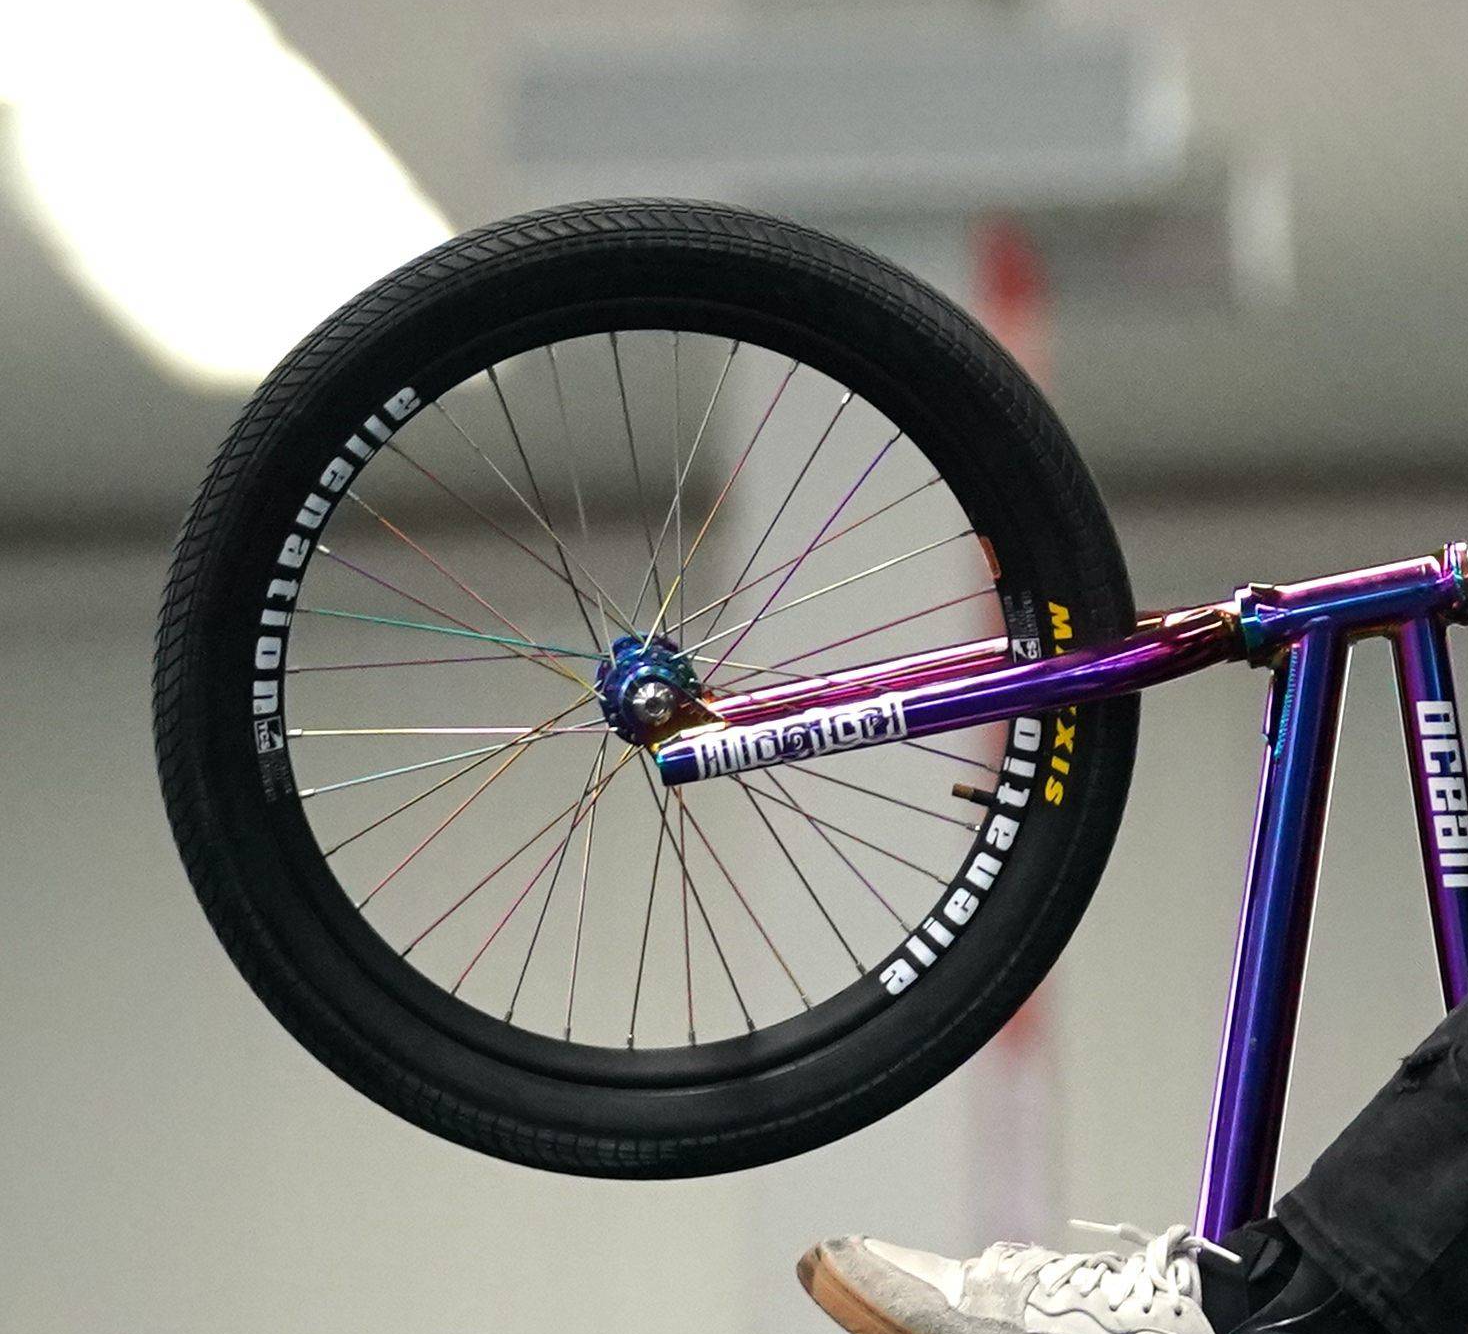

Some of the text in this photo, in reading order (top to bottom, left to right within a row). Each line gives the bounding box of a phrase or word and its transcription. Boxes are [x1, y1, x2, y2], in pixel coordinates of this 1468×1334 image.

[252, 385, 423, 716] alienation
[1044, 601, 1078, 807] MXIS
[878, 716, 1043, 997] alienatio
